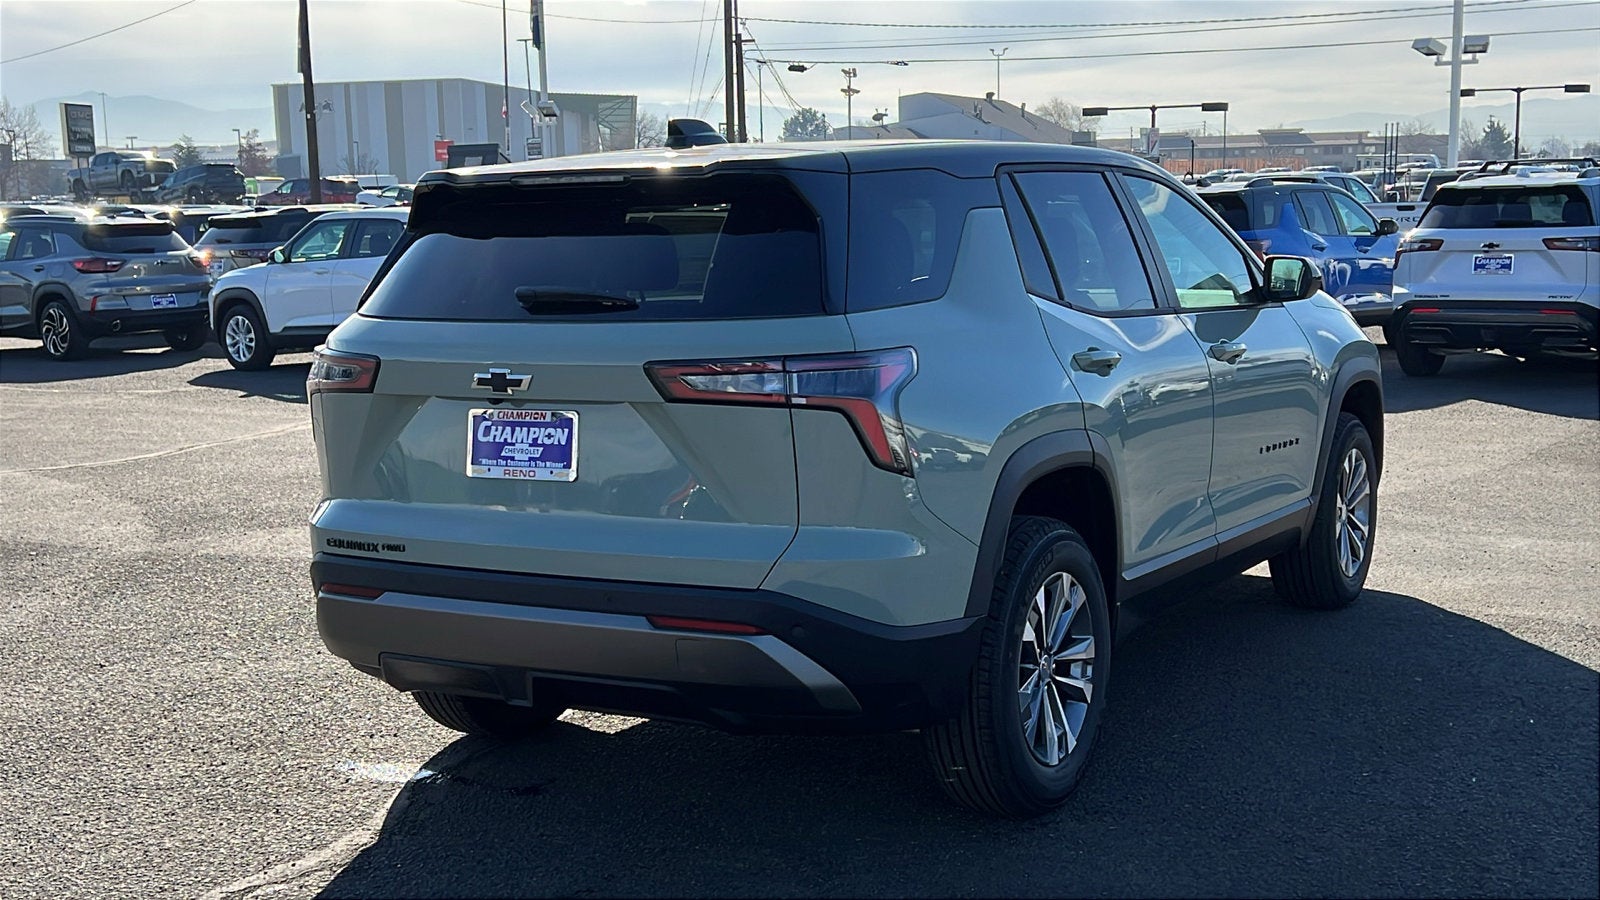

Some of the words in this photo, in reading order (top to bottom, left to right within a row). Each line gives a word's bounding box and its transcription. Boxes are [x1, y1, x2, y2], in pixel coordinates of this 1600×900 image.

[497, 410, 547, 420] CHAMPION
[477, 420, 569, 445] CHAMPION
[504, 447, 540, 455] CHEVROLET
[503, 468, 536, 478] RENO
[326, 538, 379, 553] EQUINOX
